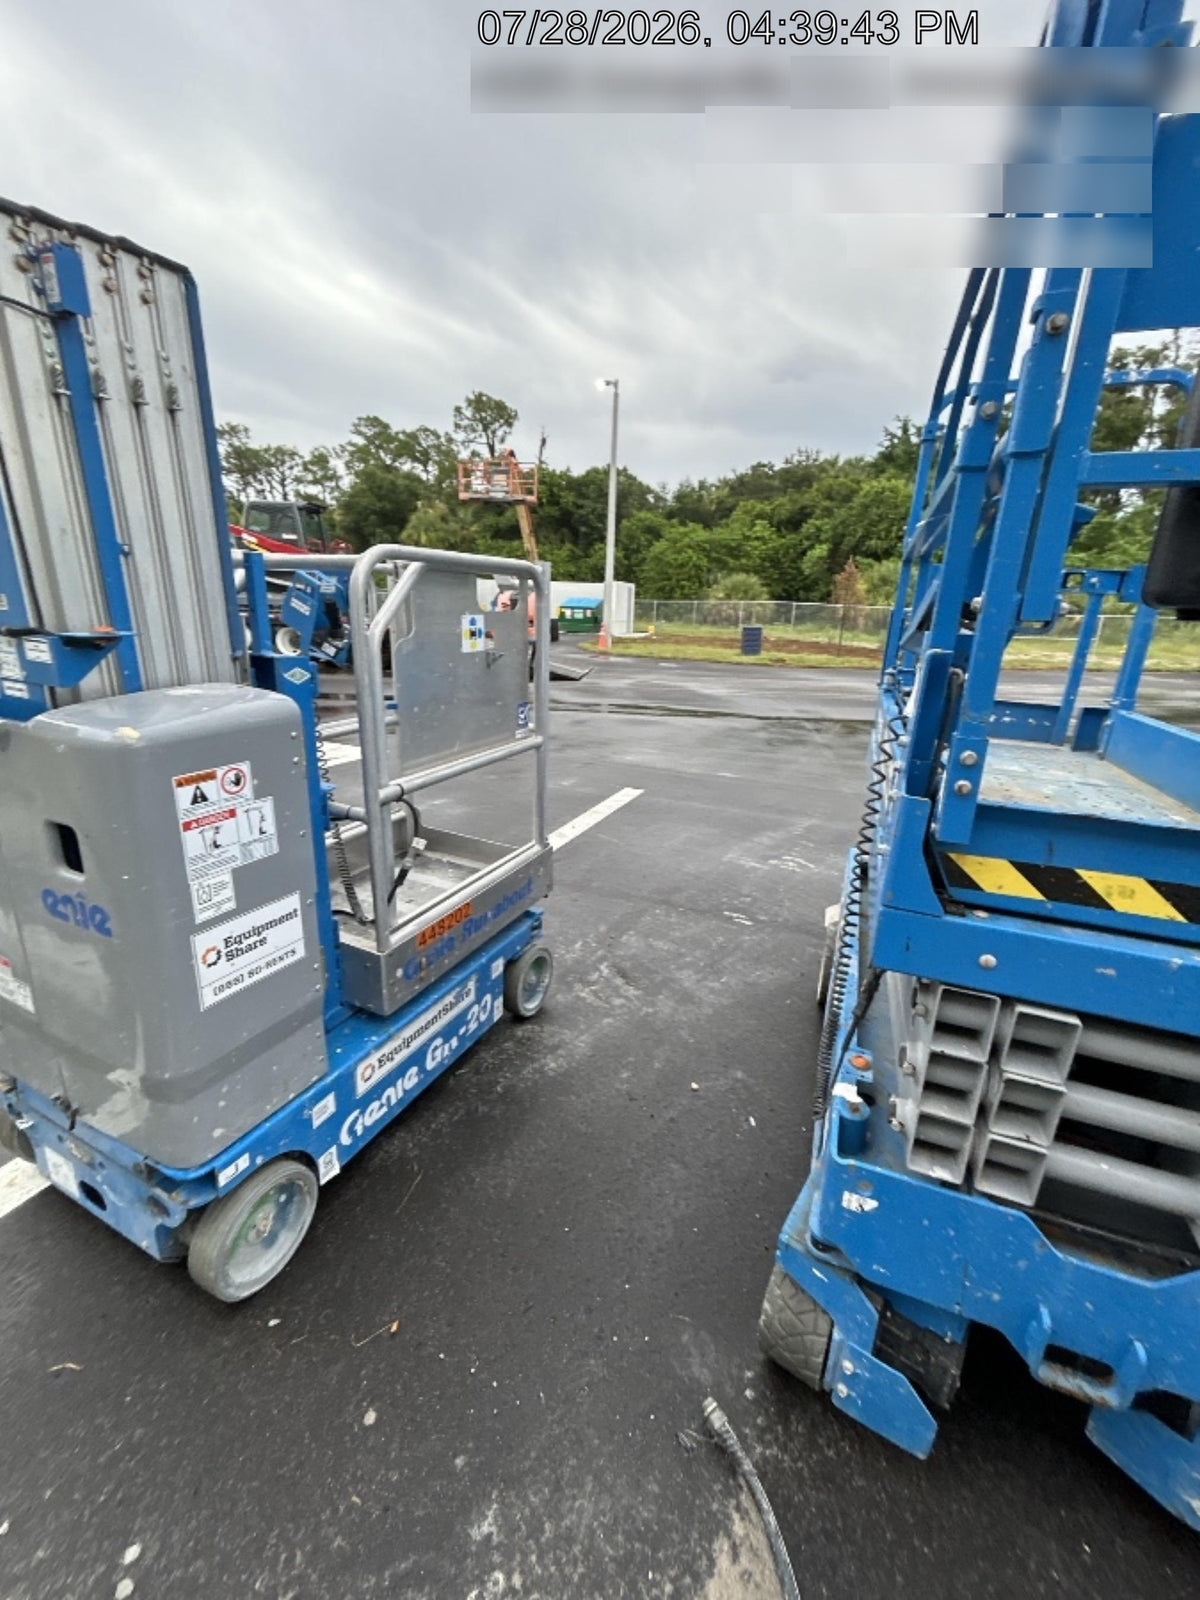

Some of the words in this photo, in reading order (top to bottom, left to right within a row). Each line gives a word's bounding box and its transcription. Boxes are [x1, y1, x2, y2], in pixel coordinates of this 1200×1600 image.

[223, 908, 298, 949] Equipment
[225, 936, 267, 962] Share
[376, 987, 472, 1070] EquipmentShe
[340, 1065, 418, 1145] Genie
